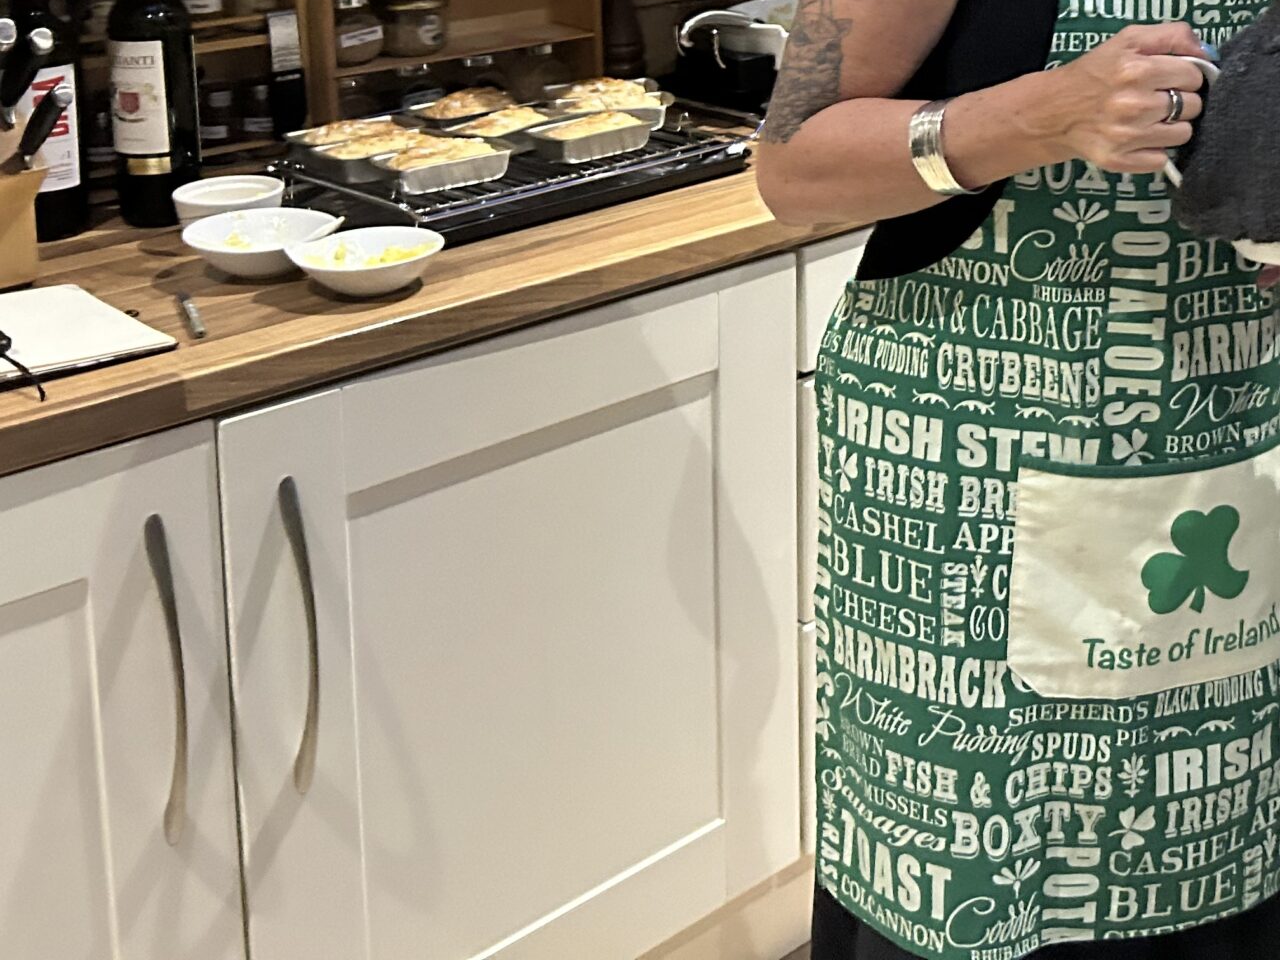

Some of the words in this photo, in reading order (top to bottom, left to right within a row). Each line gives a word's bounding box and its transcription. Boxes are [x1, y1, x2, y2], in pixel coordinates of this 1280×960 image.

[1010, 229, 1109, 283] Coddle
[874, 276, 951, 331] BACON
[951, 289, 968, 335] &
[972, 293, 1105, 353] CABBAGE
[1033, 284, 1106, 304] RHUBARB
[1103, 199, 1172, 427] POTATOES
[841, 329, 874, 368] BLACK
[874, 339, 930, 379] PUDDING
[936, 341, 1100, 409] CRUBEENS
[836, 394, 944, 463] IRISH
[956, 422, 1102, 473] STEW
[1165, 421, 1241, 455] BROWN
[864, 456, 949, 515] IRISH
[834, 493, 946, 556] CASHEL
[952, 521, 1017, 556] APP
[832, 533, 933, 604] BLUE
[832, 583, 936, 645] CHEESE
[1082, 638, 1161, 671] Taste
[1168, 628, 1200, 662] of
[1204, 601, 1280, 656] Ireland
[832, 617, 1008, 709] BARMBRACK
[834, 672, 912, 737] White
[918, 705, 1034, 767] Pudding
[1009, 700, 1149, 728] SHEPHERD'S
[1154, 684, 1200, 719] BLACK
[1204, 669, 1264, 708] PUDDING
[1031, 731, 1112, 763] SPUDS
[1115, 725, 1149, 747] PIE
[1155, 722, 1273, 798] IRISH
[820, 764, 947, 852] Sausages
[861, 780, 949, 829] MUSSELS
[884, 749, 959, 805] FISH
[970, 771, 993, 809] &
[1005, 761, 1113, 809] CHIPS
[1164, 780, 1252, 839] IRISH
[950, 800, 1107, 862] BOXTY
[1108, 825, 1246, 877] CASHEL
[840, 808, 953, 922] TOAST
[1104, 862, 1238, 923] BLUE
[841, 873, 947, 954] COLCANNON
[944, 891, 1041, 949] Coddle
